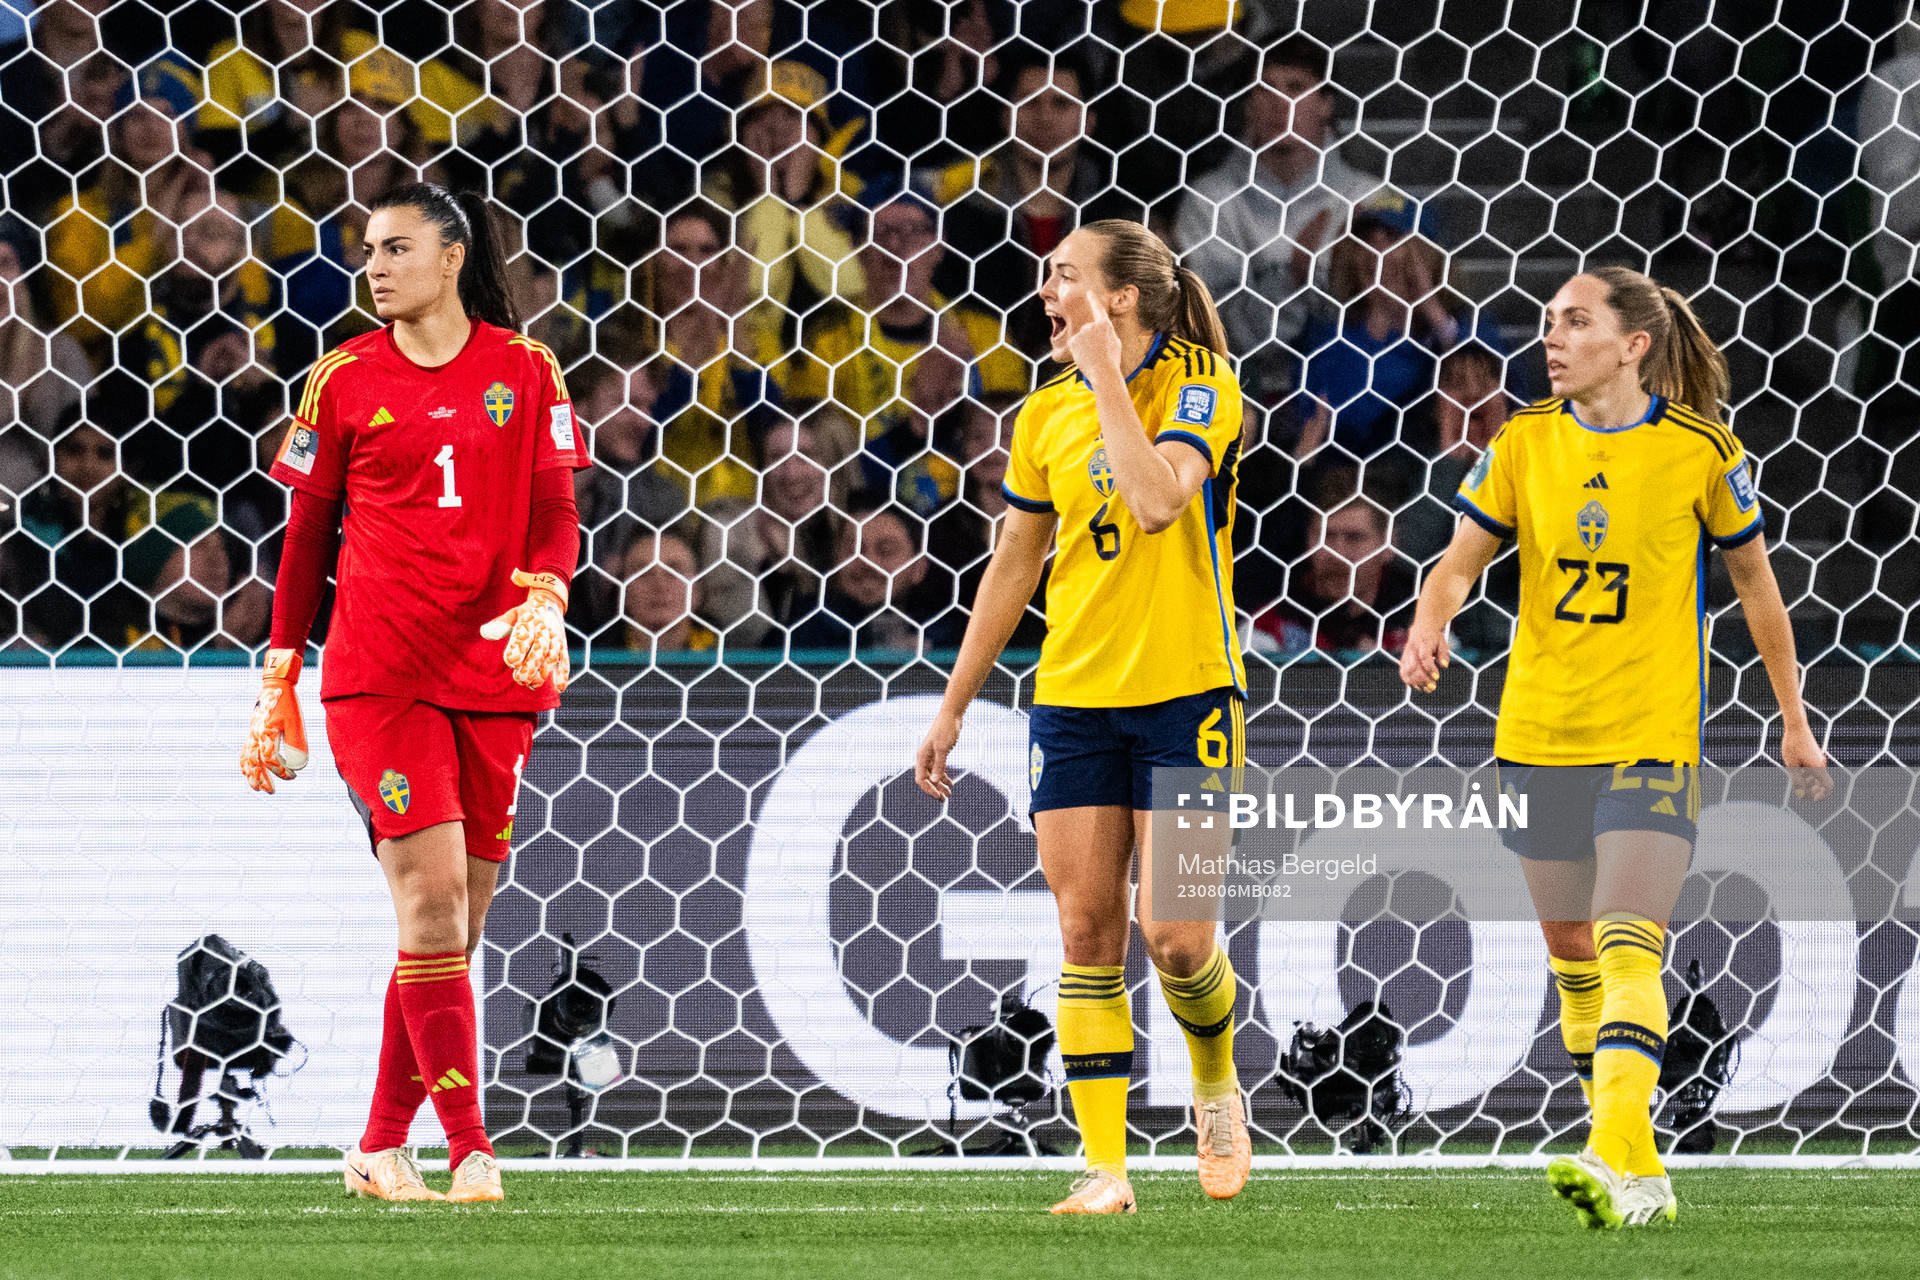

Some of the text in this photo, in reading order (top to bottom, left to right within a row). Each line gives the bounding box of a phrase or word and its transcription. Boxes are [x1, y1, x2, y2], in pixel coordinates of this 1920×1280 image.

[434, 445, 462, 507] 1
[1089, 503, 1120, 561] 6
[1554, 558, 1630, 624] 23
[1197, 707, 1228, 768] 6
[508, 754, 524, 815] 1
